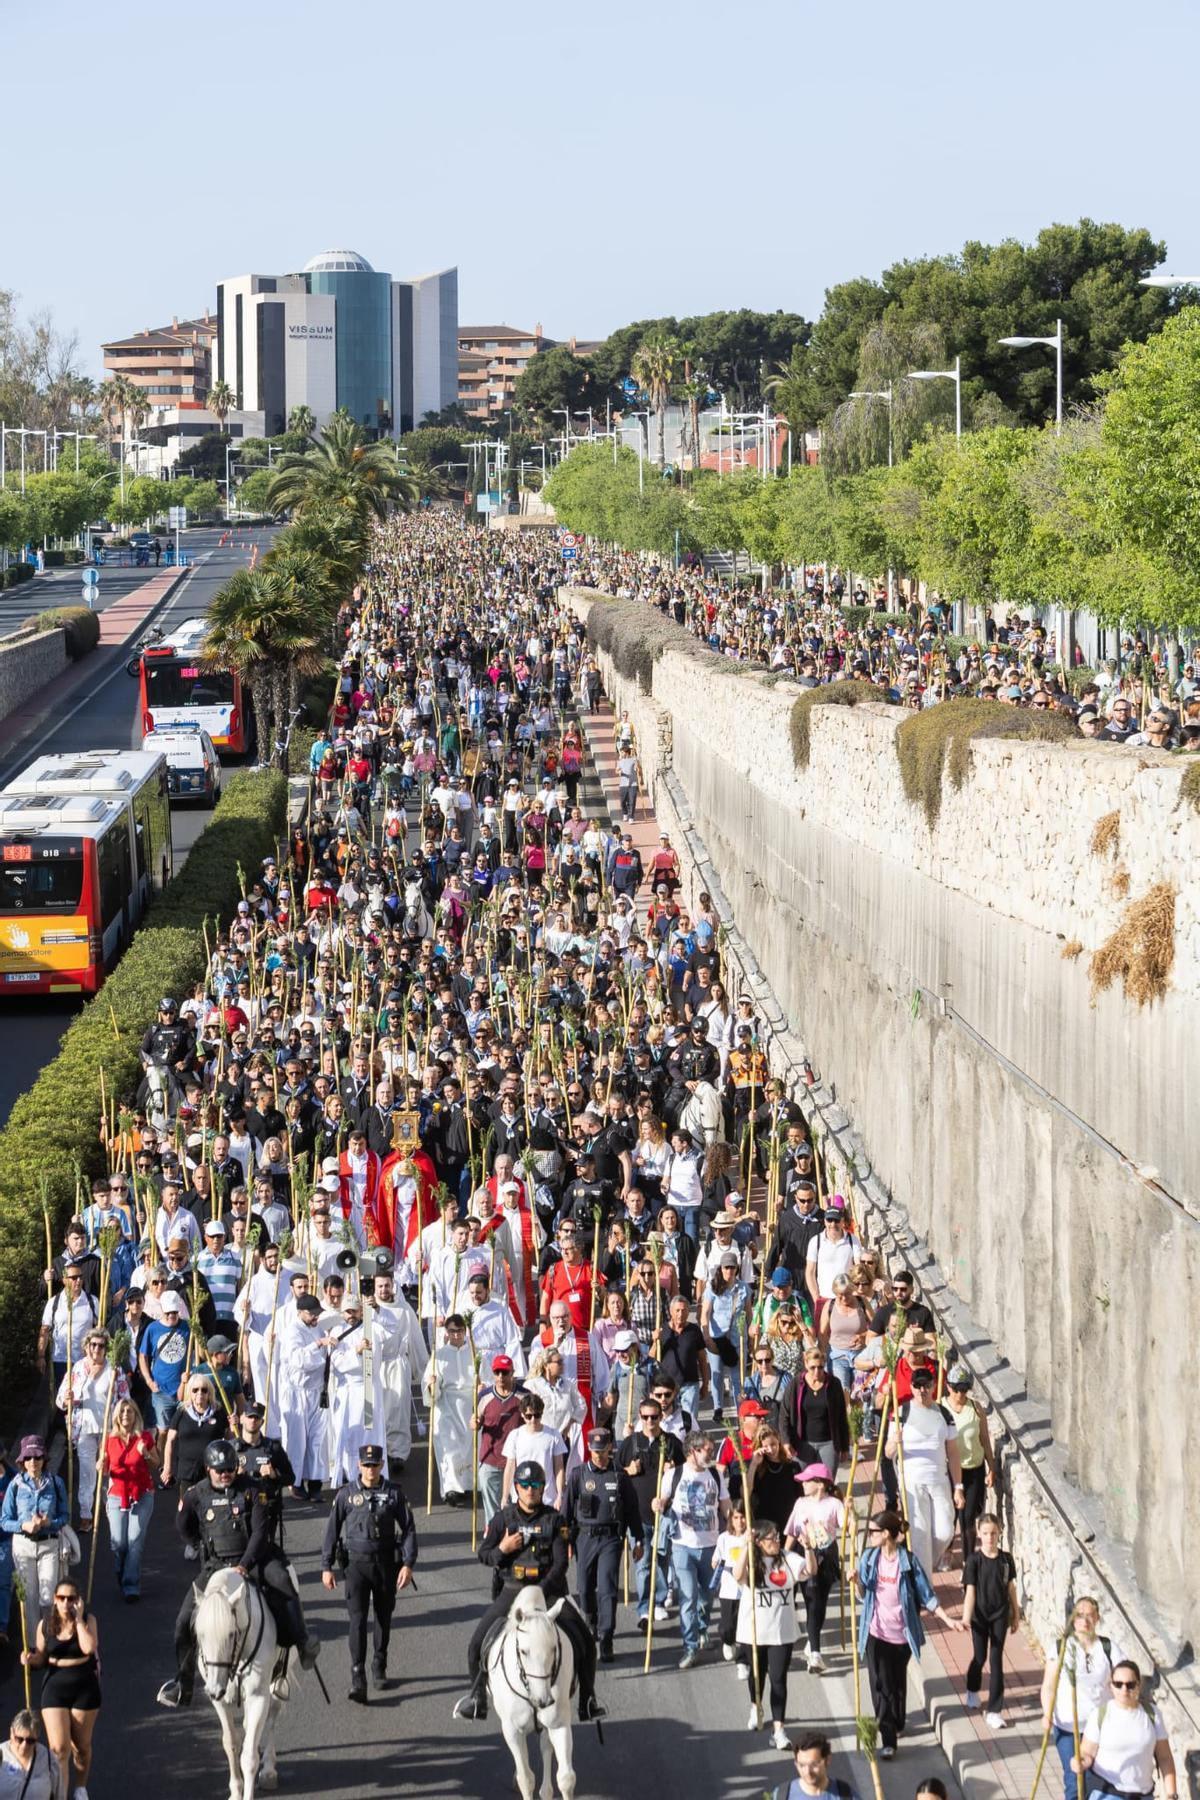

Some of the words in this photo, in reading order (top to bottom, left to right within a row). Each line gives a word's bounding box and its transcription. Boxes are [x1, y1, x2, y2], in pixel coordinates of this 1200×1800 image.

[289, 325, 333, 334] VISSUM
[43, 849, 59, 857] 818
[757, 1588, 791, 1608] NY
